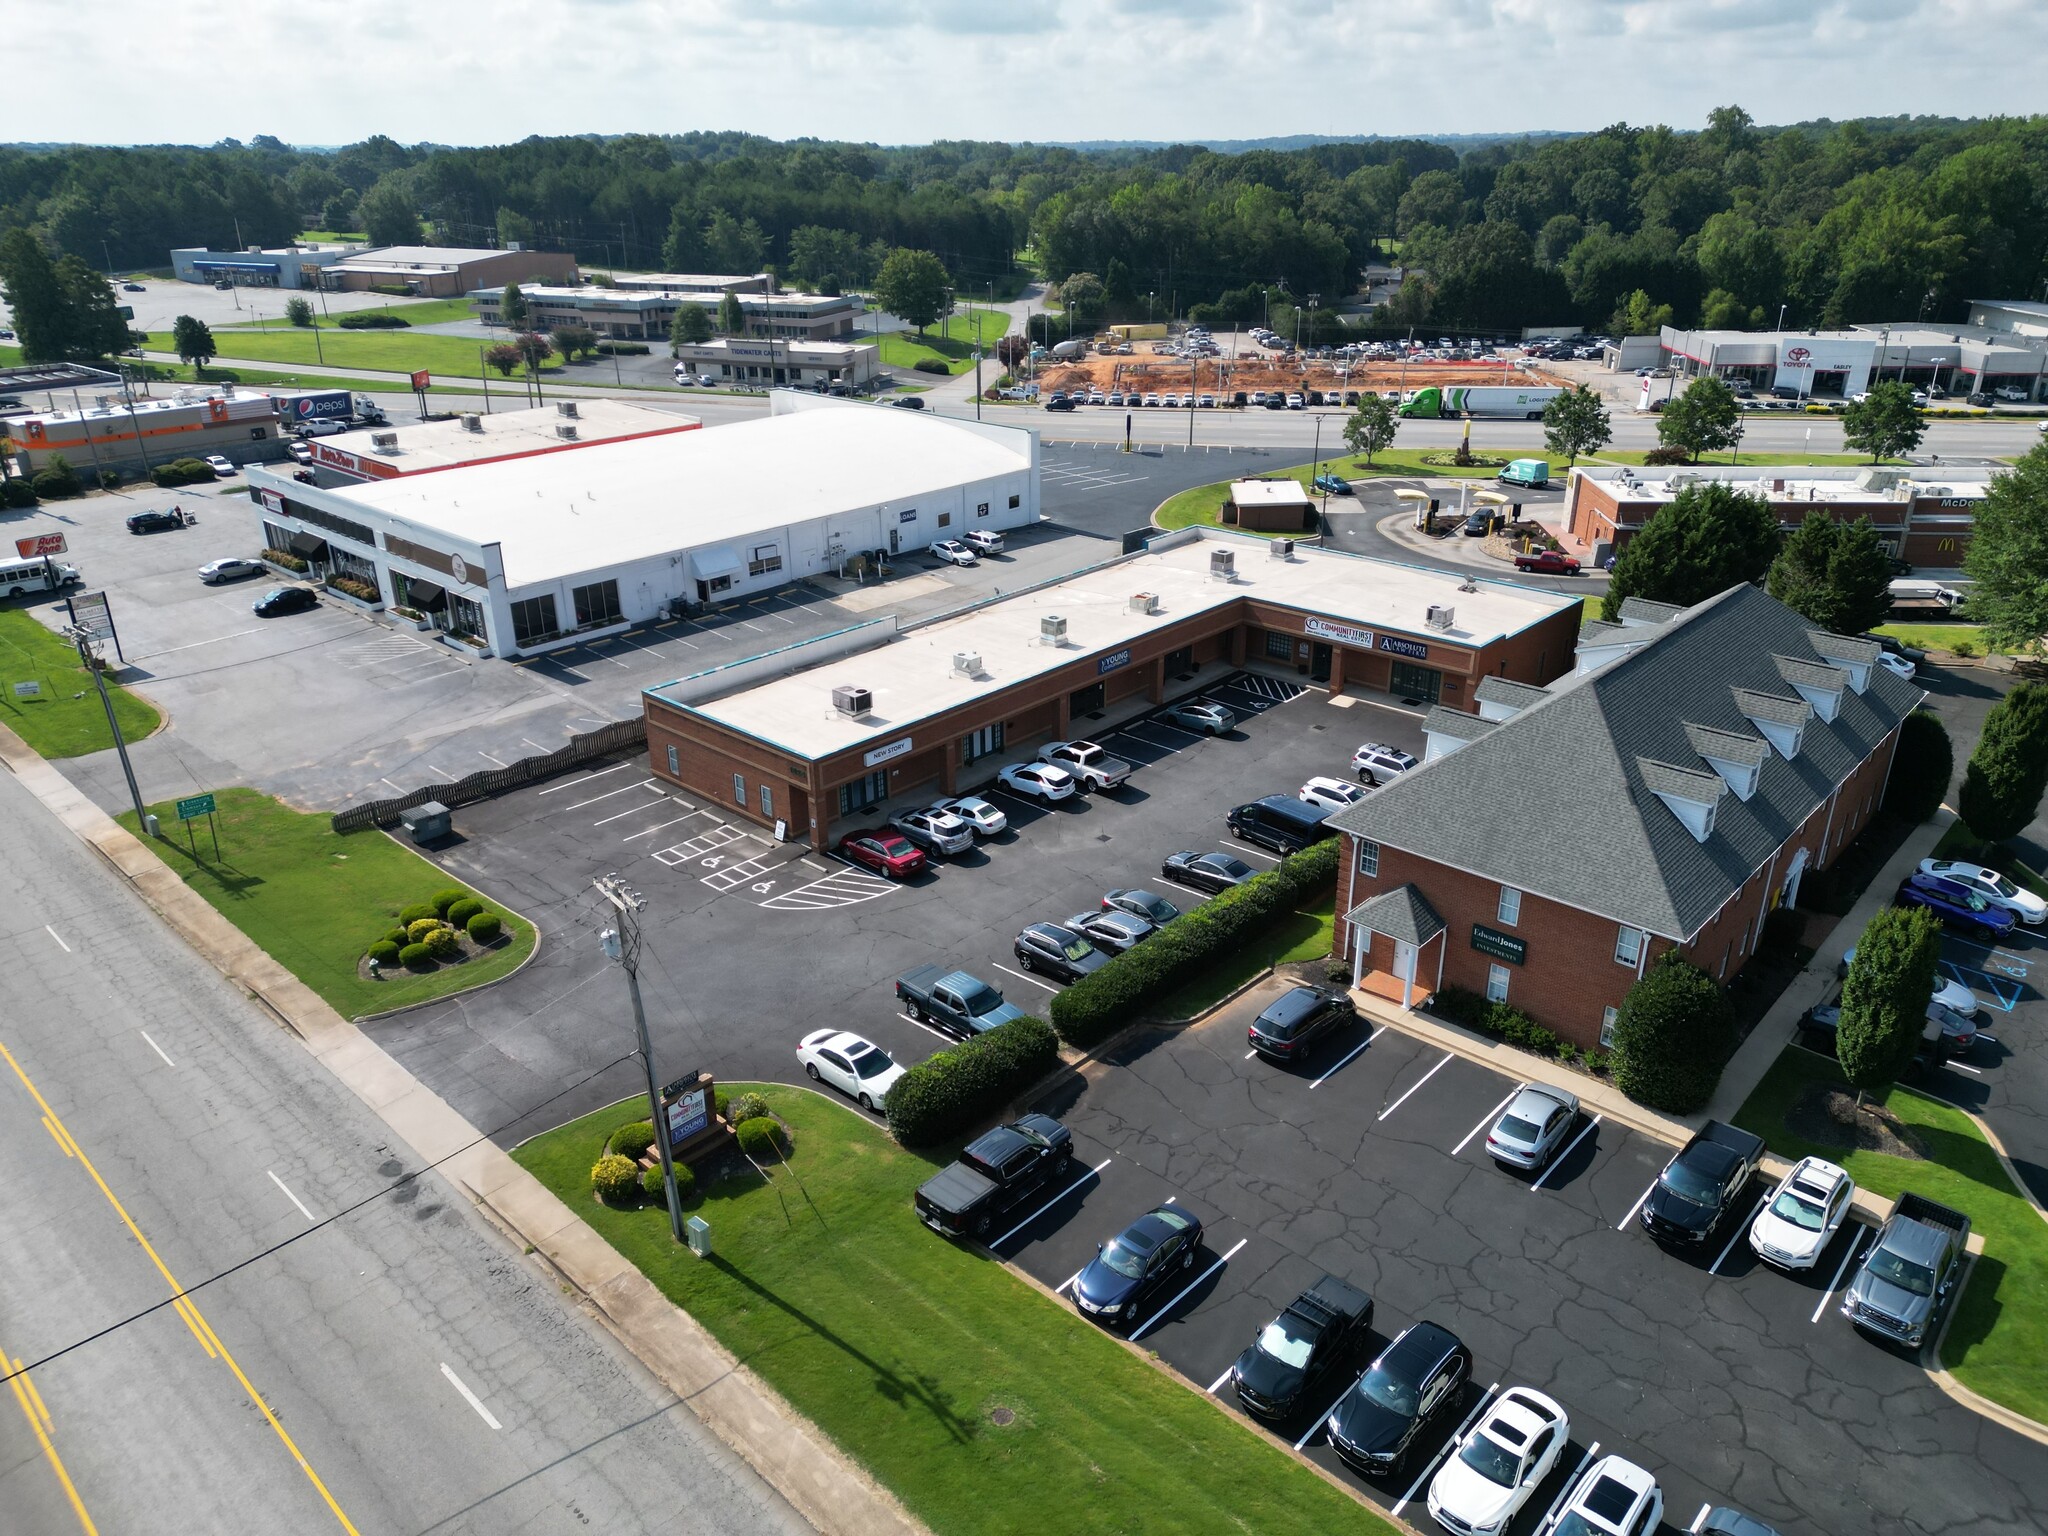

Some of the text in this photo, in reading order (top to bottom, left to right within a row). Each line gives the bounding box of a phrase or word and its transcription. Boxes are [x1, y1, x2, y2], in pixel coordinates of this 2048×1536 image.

[731, 348, 762, 357] TIDEWATER
[316, 399, 346, 414] pepsi
[901, 511, 917, 521] LOANS
[38, 535, 62, 546] Auto
[35, 544, 62, 555] Zone
[1392, 645, 1426, 658] LAW FIRM
[1393, 640, 1426, 653] ABSOLUTE
[1105, 650, 1128, 665] YOUNG
[873, 743, 905, 759] NEW STORY
[1476, 943, 1517, 961] INVESTMENTS
[680, 1116, 704, 1133] YOUNG
